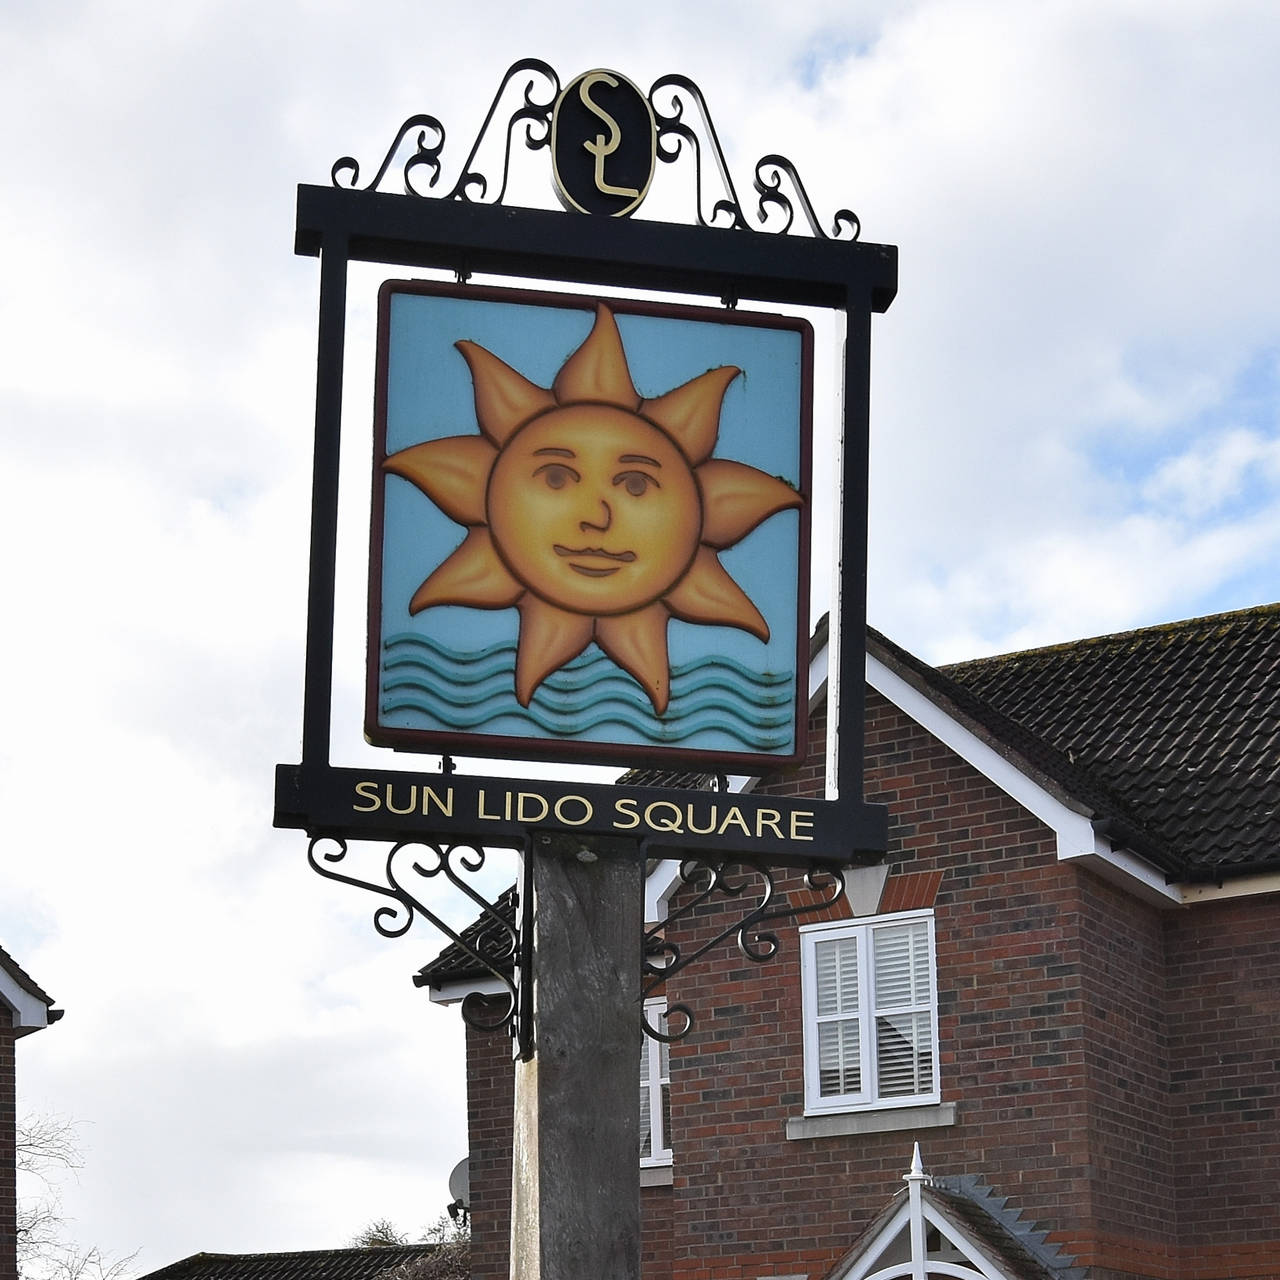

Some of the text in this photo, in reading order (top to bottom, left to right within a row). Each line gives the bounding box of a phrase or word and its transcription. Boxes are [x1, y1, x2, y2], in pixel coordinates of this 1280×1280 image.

[353, 782, 815, 841] SUN LIDO SQUARE
